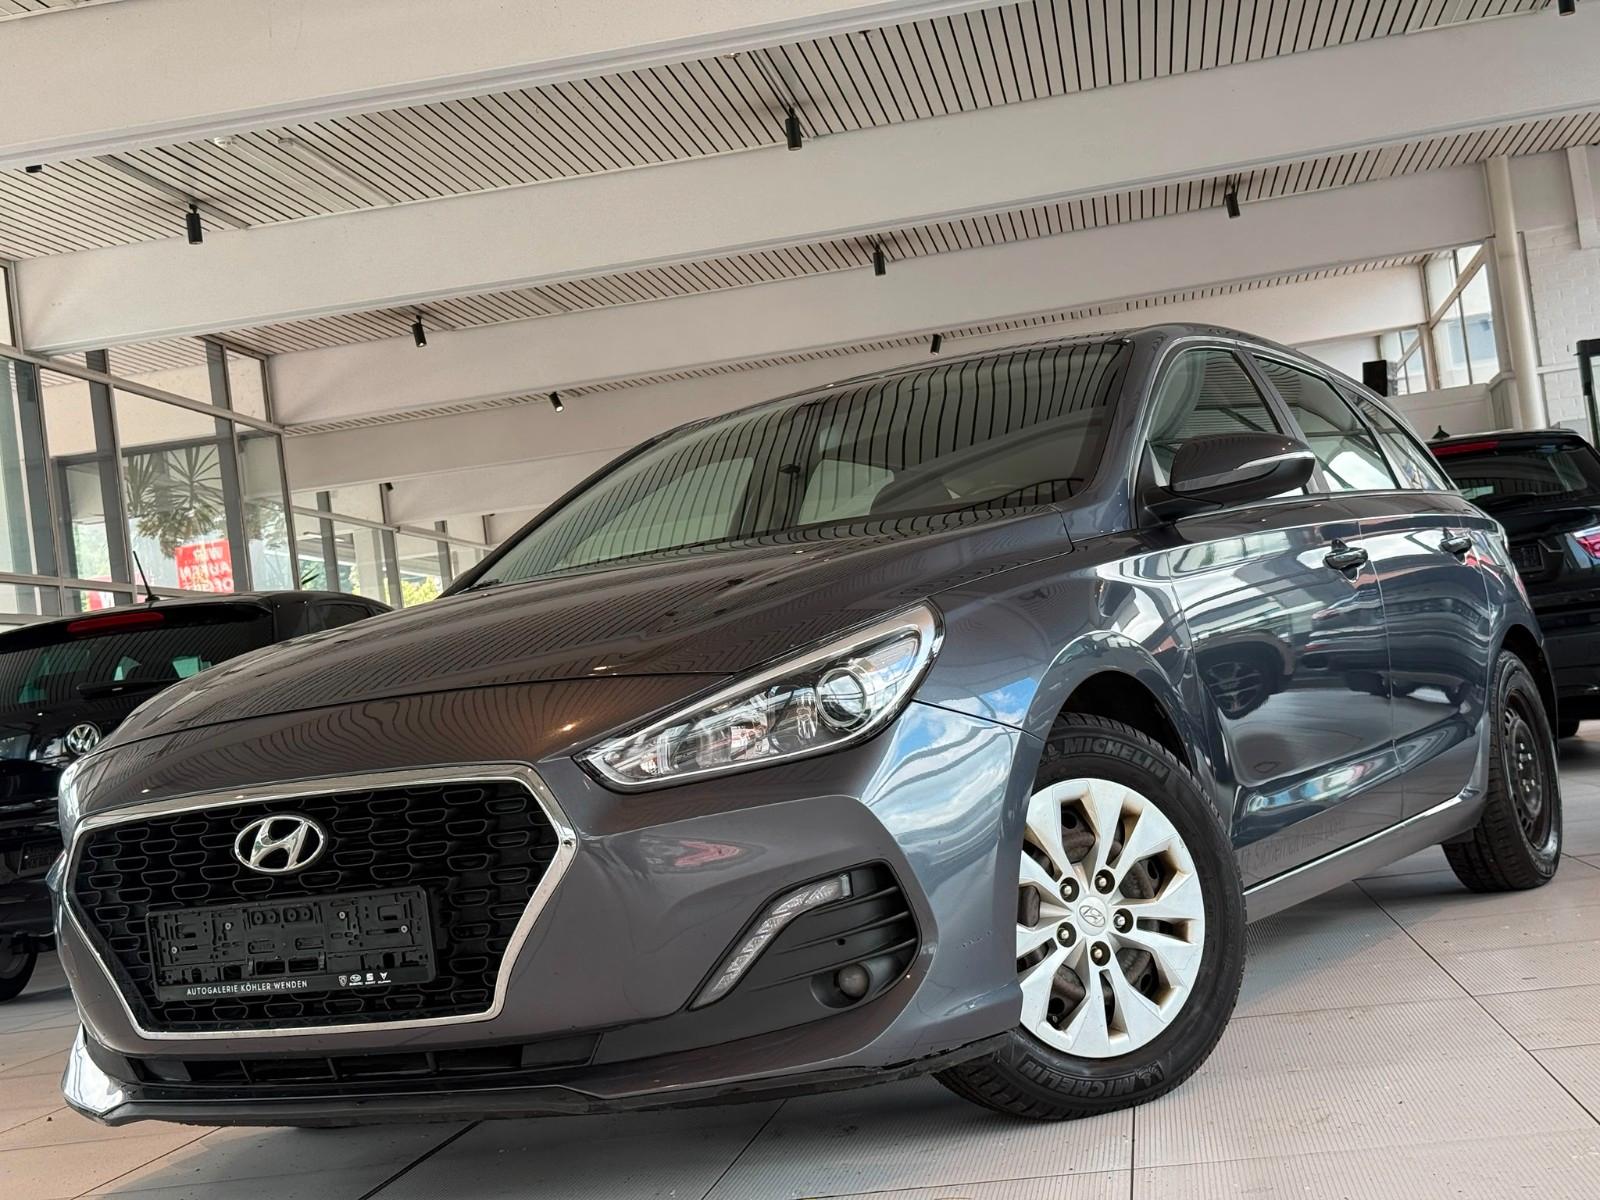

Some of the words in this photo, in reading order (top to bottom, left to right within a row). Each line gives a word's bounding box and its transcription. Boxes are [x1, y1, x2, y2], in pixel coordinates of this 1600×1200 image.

[1063, 738, 1170, 779] MICHELIN
[186, 984, 238, 996] AUTOGALERIE
[240, 982, 271, 993] KÖHLER
[273, 979, 308, 990] WENDEN
[1019, 1060, 1136, 1098] MICHELIN
